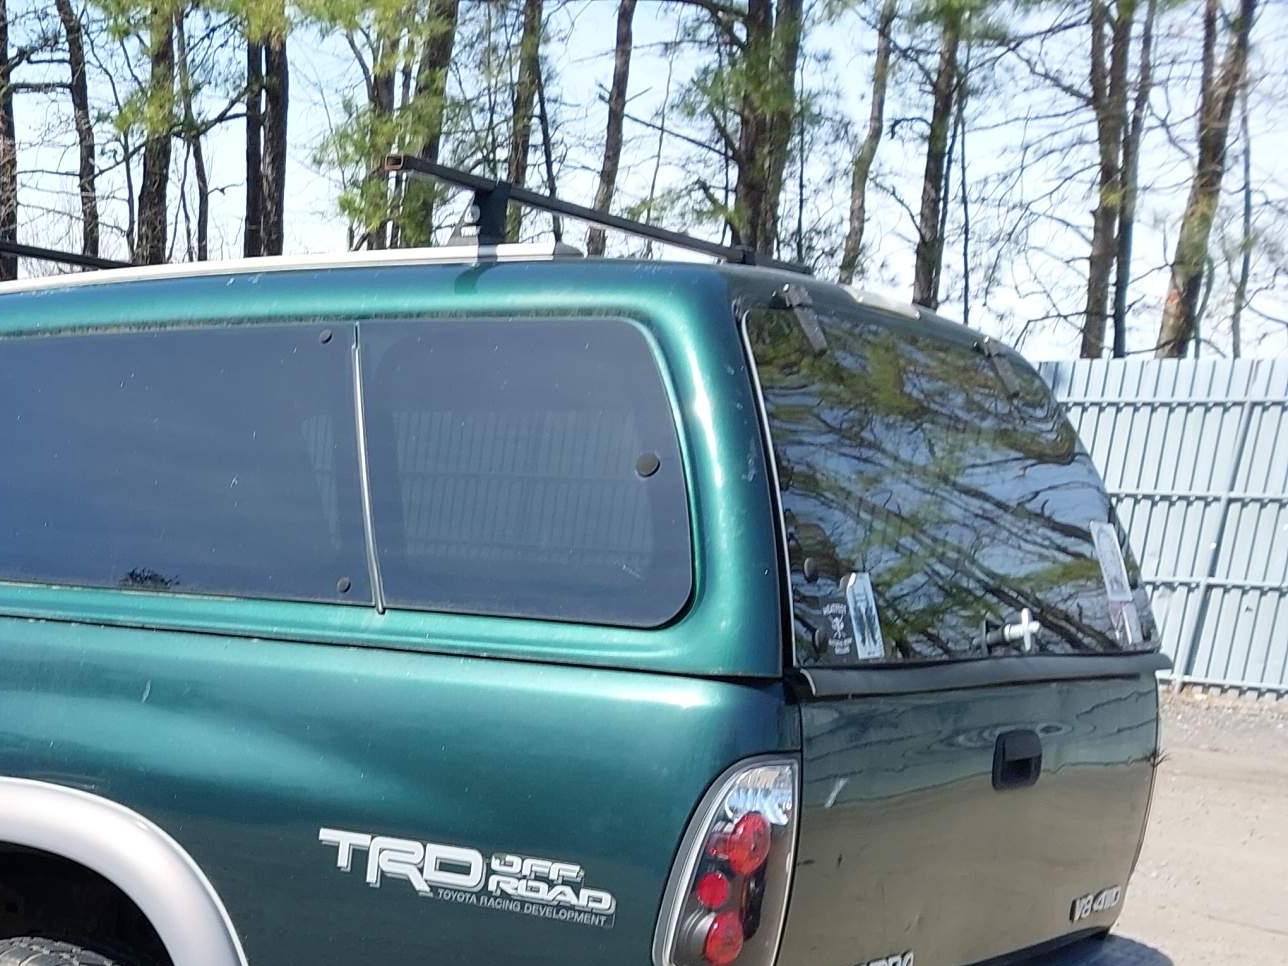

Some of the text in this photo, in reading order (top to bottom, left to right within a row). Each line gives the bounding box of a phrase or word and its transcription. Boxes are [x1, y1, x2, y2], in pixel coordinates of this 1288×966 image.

[318, 827, 486, 897] TRD
[490, 852, 584, 883] OFF
[437, 888, 608, 928] TOYOTA RACING DEVELOPMENT
[487, 873, 617, 914] ROAD
[1073, 894, 1093, 921] V8
